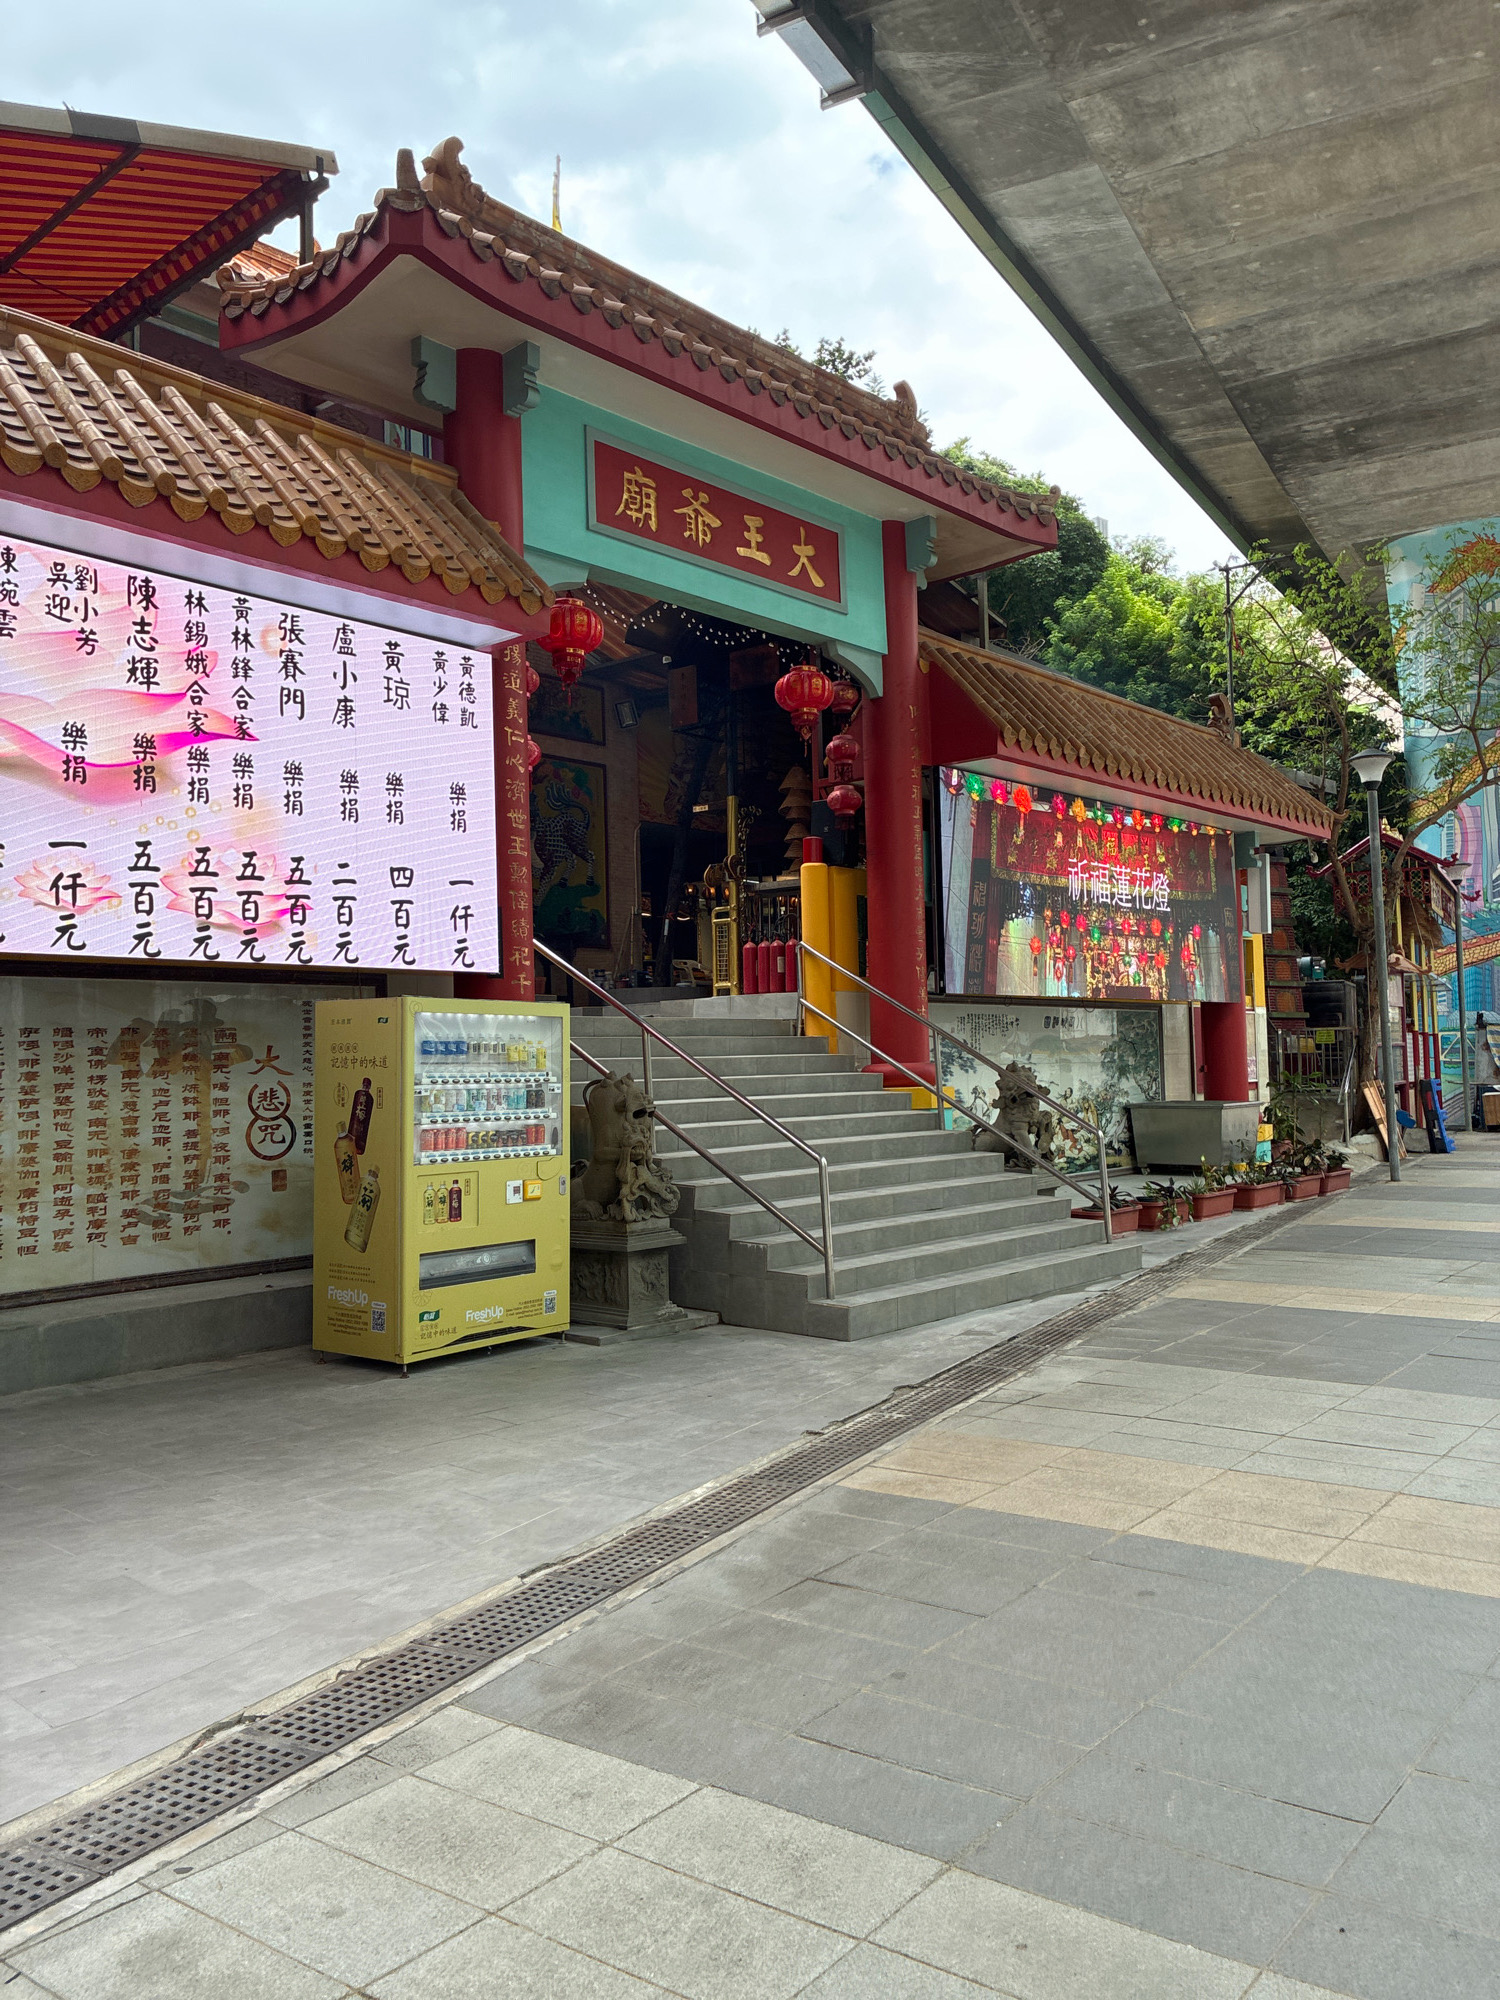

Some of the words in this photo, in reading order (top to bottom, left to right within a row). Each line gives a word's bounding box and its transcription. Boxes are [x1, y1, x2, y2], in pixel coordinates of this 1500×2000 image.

[44, 561, 73, 624] 吳迎
[74, 564, 99, 656] 劉小芳
[126, 573, 161, 692] 陳志輝
[184, 589, 210, 737] 林錫娥合家
[230, 597, 256, 741] 黃林鋒合家
[278, 612, 306, 721] 張賽門
[332, 622, 358, 728] 盧小康
[432, 650, 449, 724] 黃少偉
[458, 655, 478, 729] 黃德凱
[61, 721, 88, 785] 樂捐
[132, 733, 157, 794] 樂捐
[186, 747, 210, 804] 樂捐
[232, 753, 255, 811] 樂捐
[282, 760, 304, 817] 樂捐
[339, 769, 359, 824] 樂捐
[385, 772, 404, 825] 樂捐
[449, 781, 467, 833] 樂捐
[48, 841, 87, 951] 一仟元
[127, 840, 162, 959] 五百元
[188, 846, 221, 961] 五百元
[235, 852, 266, 963] 五百元
[283, 856, 314, 965] 五百元
[332, 862, 360, 965] 二百元
[389, 866, 416, 966] 四百元
[448, 880, 475, 969] 一仟元
[328, 1286, 369, 1307] FreshUp
[466, 1305, 504, 1322] FreshUp
